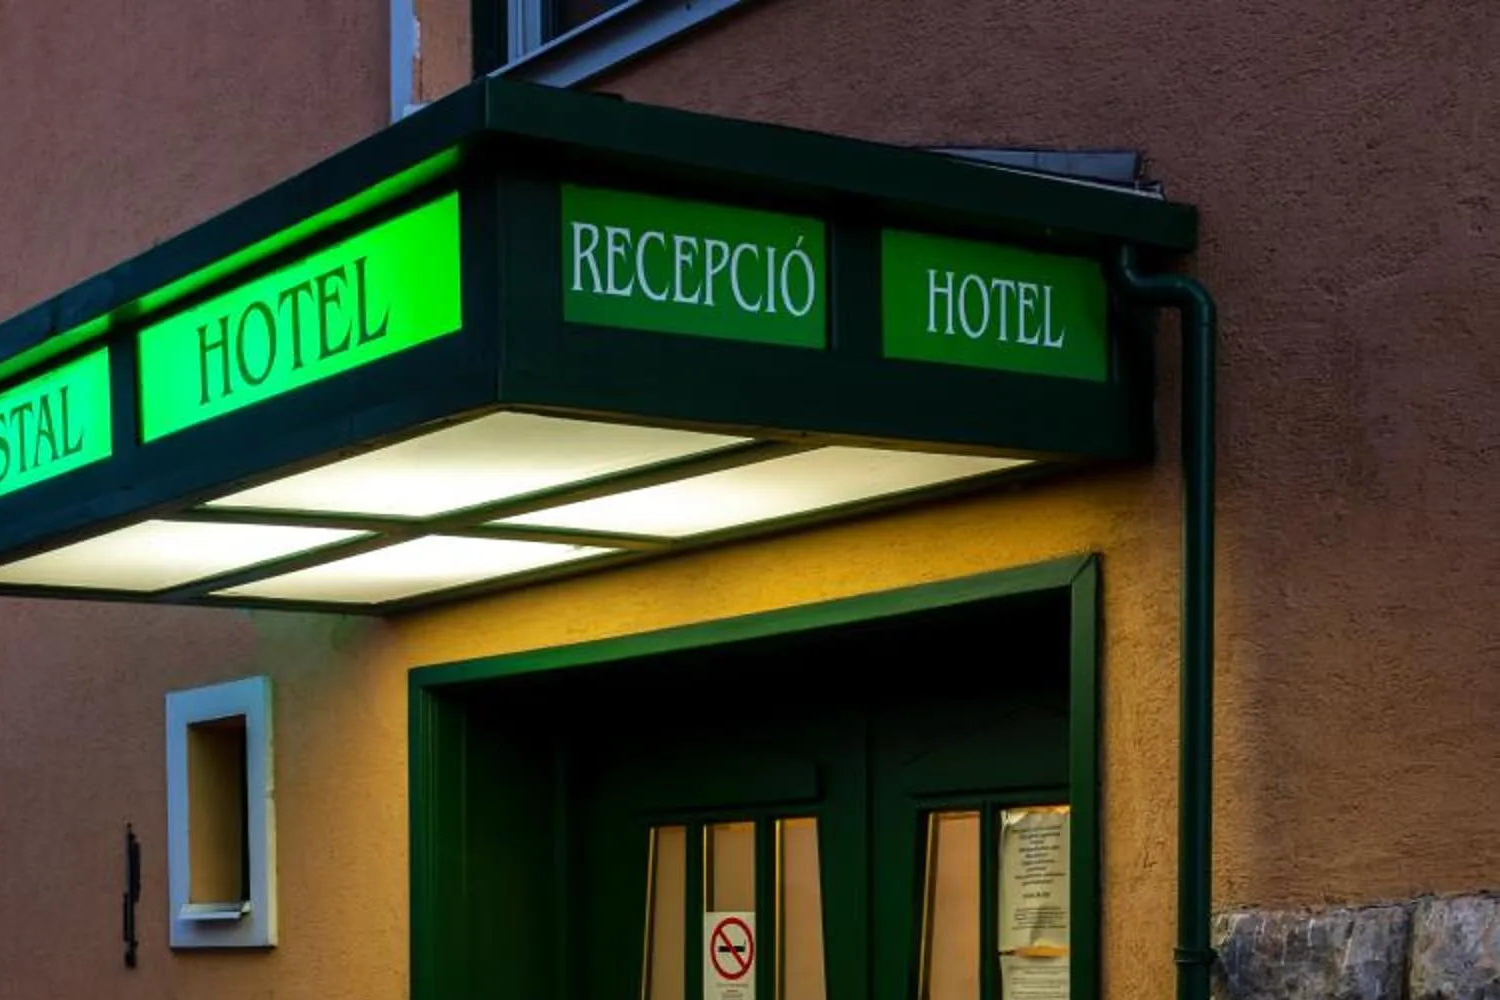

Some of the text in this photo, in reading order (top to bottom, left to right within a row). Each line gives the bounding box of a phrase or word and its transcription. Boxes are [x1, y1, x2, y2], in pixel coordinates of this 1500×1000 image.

[197, 256, 389, 405] HOTEL
[571, 222, 1064, 349] RECEPCIÓ HOTEL
